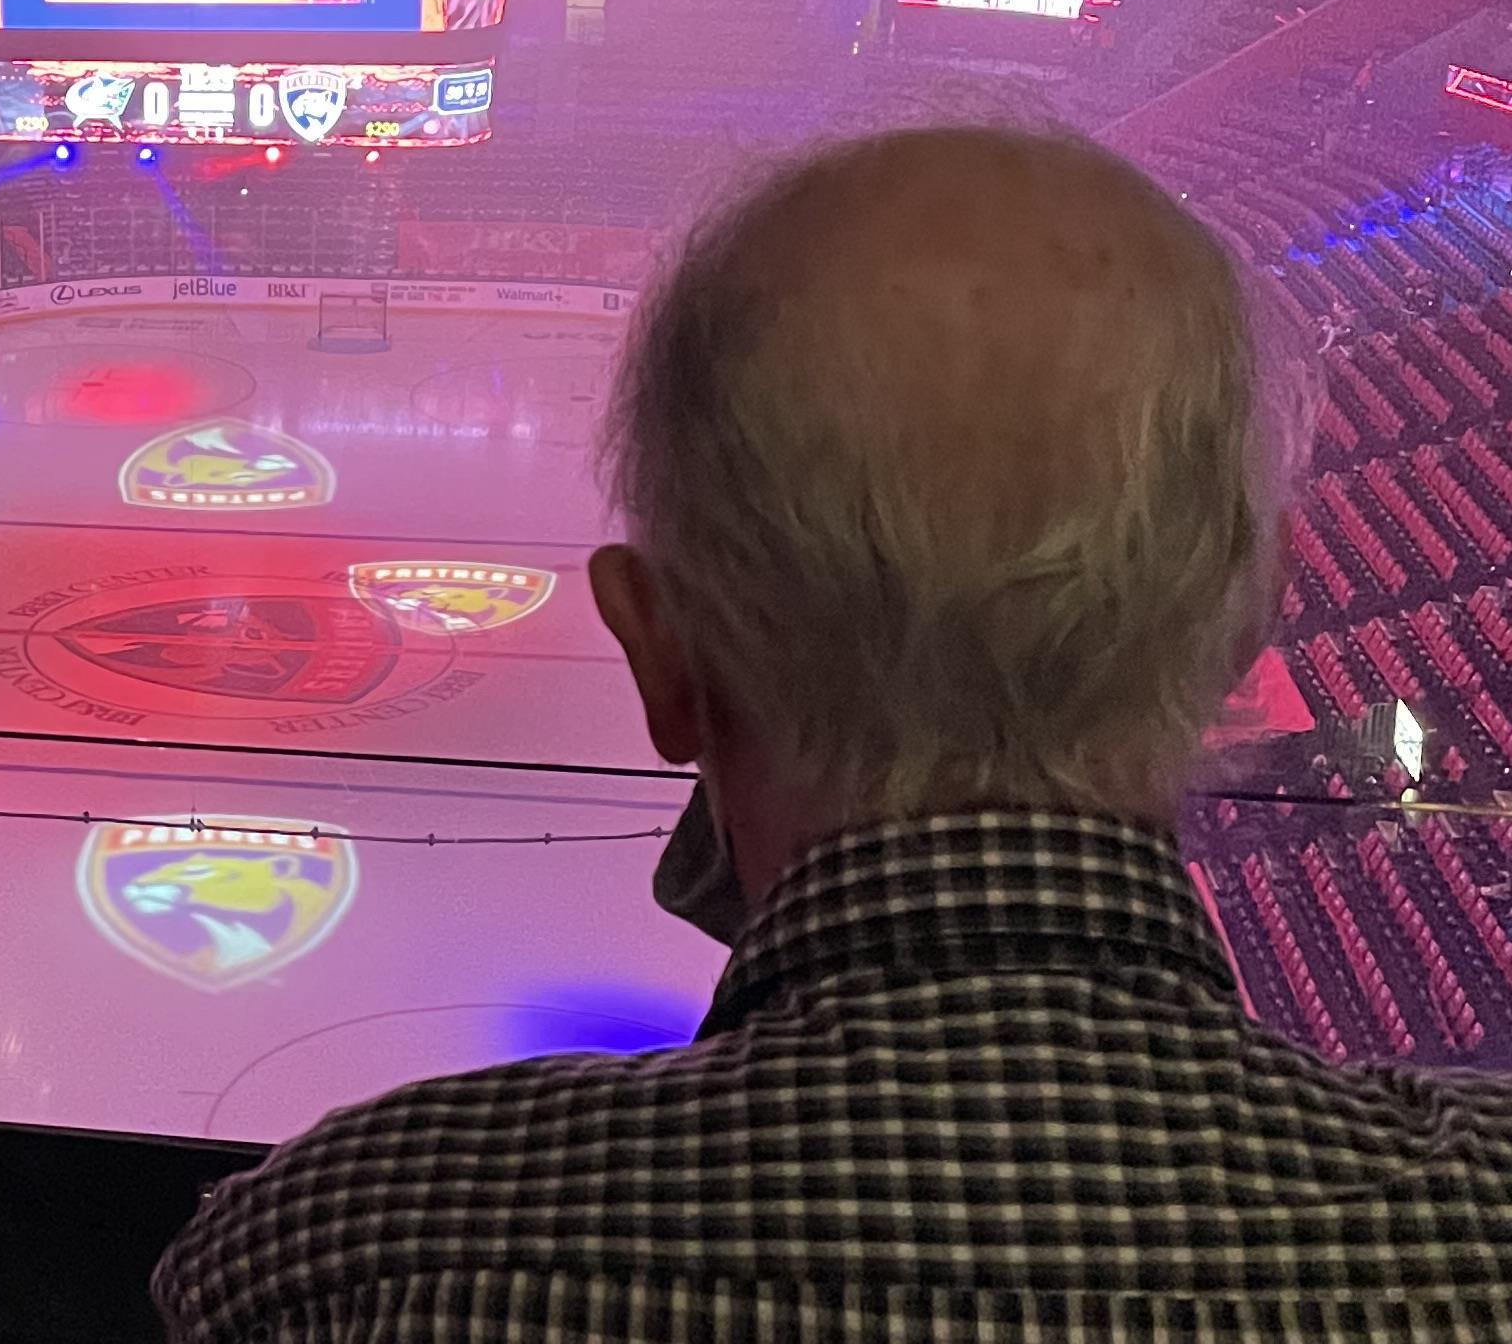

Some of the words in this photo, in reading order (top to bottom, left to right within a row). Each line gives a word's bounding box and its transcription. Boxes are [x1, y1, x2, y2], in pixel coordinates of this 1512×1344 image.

[143, 82, 169, 125] 0
[249, 83, 275, 126] 0
[77, 284, 143, 299] LEXUS
[172, 277, 237, 300] jetBlue
[266, 283, 309, 298] BB&T
[496, 286, 554, 303] Walmart
[67, 565, 211, 593] CENTER
[375, 567, 528, 586] PANTHERS
[269, 697, 430, 735] CENTER
